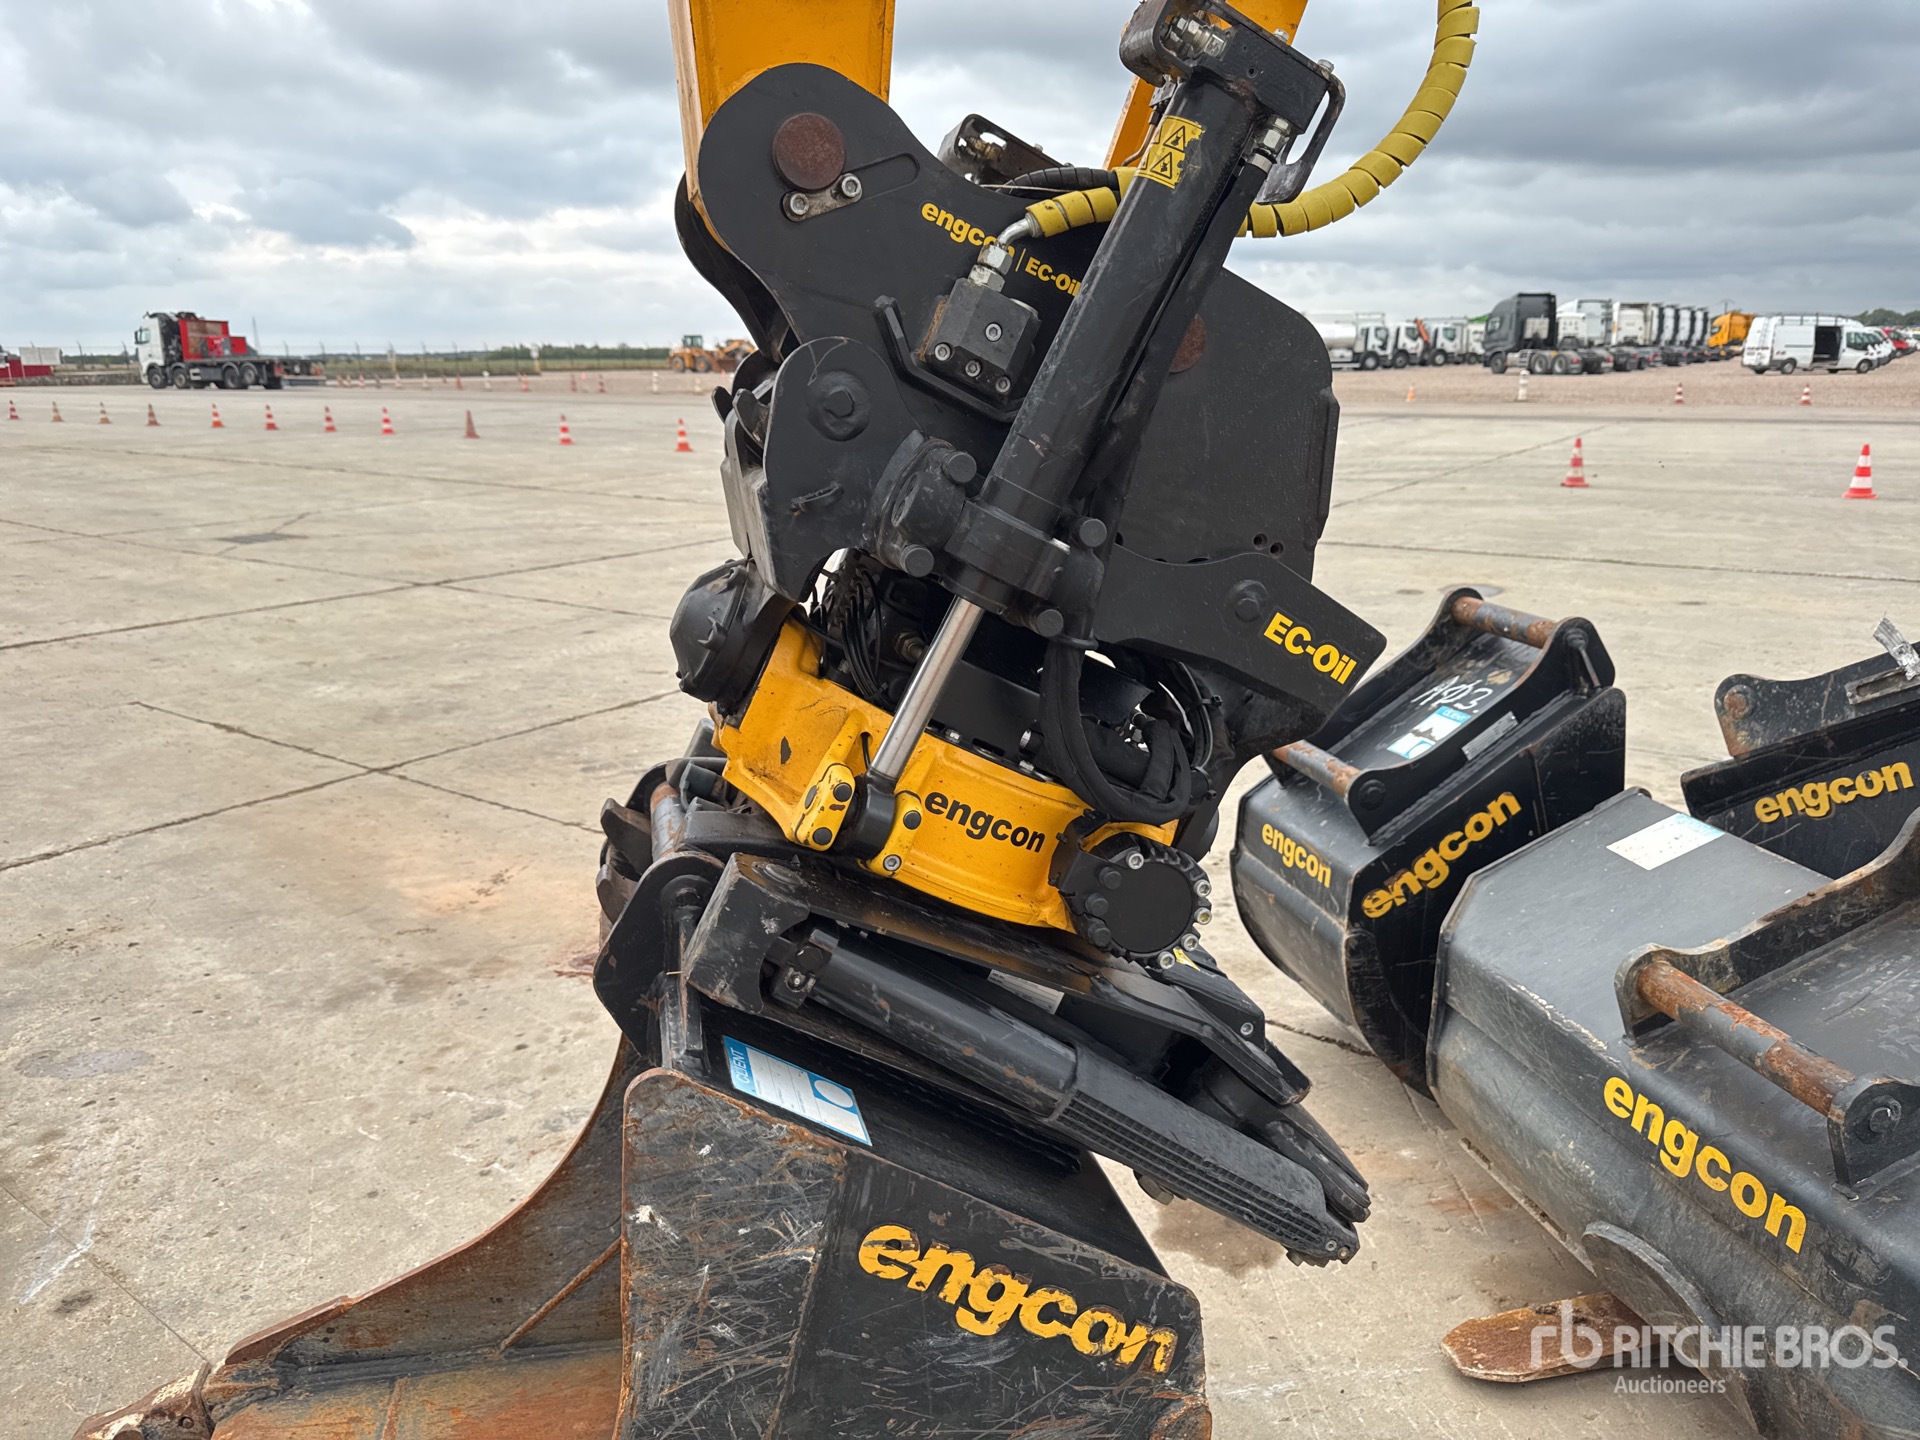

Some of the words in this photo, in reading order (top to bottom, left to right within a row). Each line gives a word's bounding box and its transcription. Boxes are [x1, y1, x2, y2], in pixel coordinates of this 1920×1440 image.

[1025, 256, 1081, 297] EC-Oil
[1263, 612, 1357, 685] EC-Oil
[924, 791, 1045, 853] engcon
[1754, 761, 1914, 823] engcon
[1261, 823, 1332, 888] engcon
[1361, 791, 1521, 919] engcon
[730, 1047, 750, 1084] CLIENT
[1603, 1076, 1807, 1254] engcon
[858, 1224, 1178, 1374] engcon
